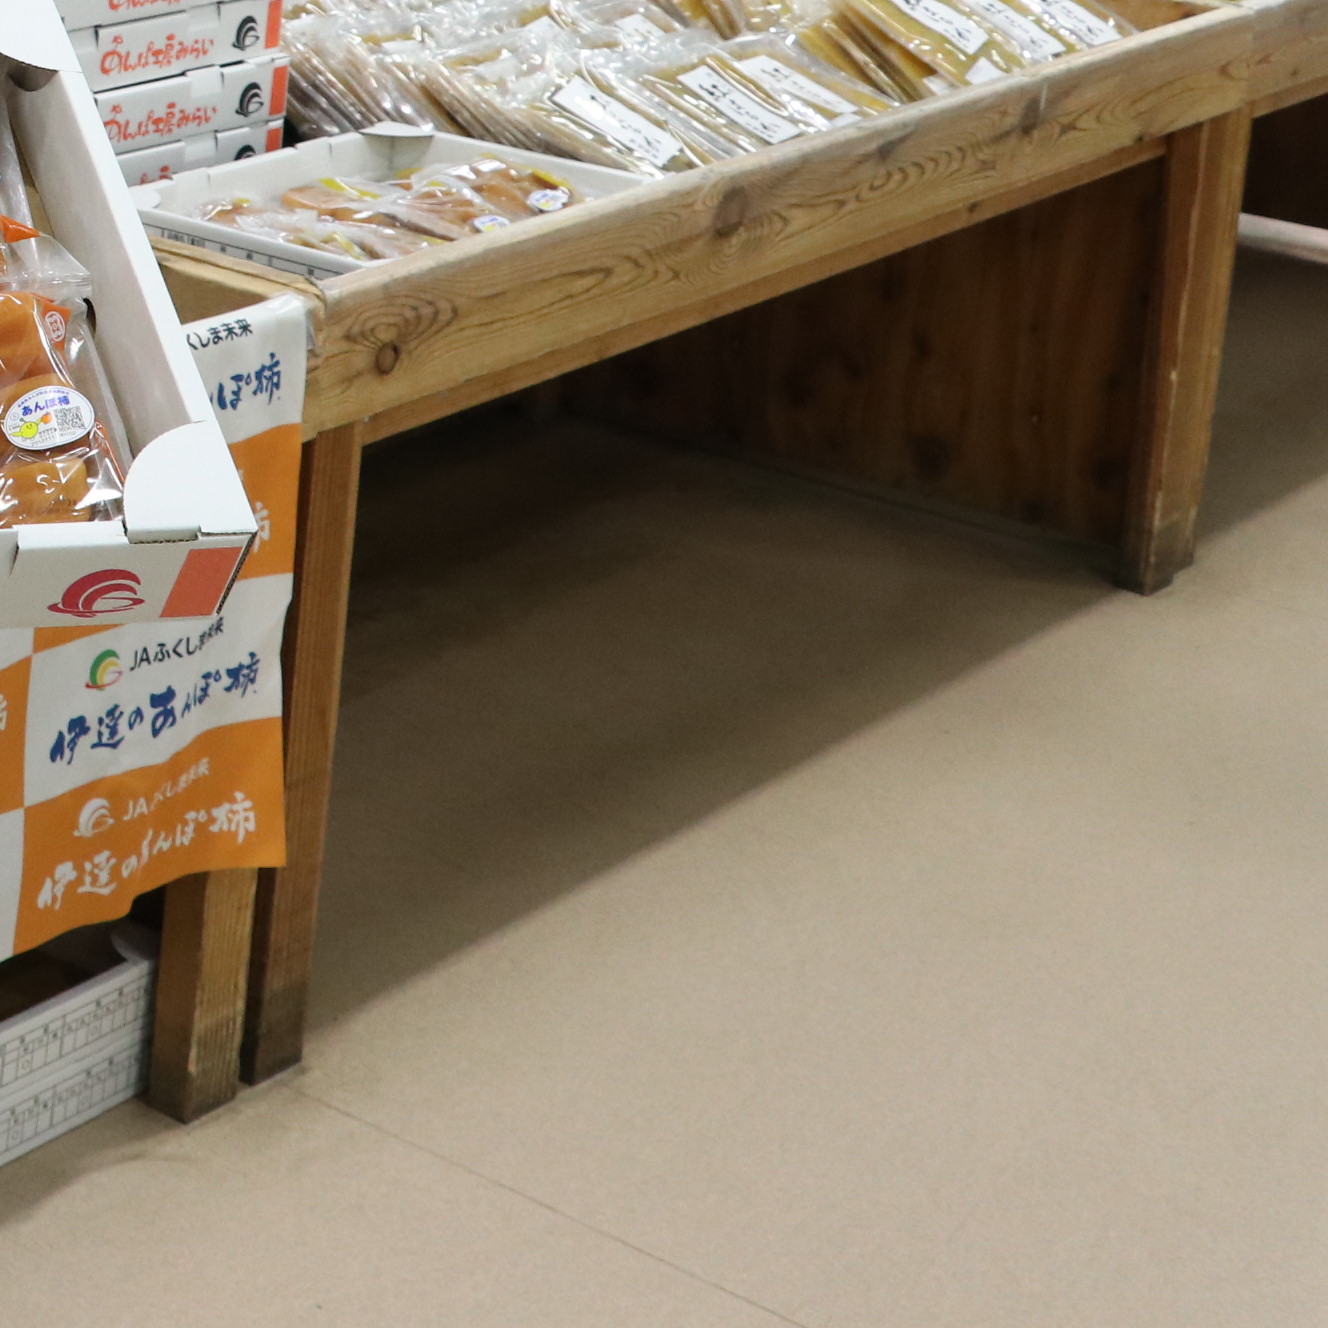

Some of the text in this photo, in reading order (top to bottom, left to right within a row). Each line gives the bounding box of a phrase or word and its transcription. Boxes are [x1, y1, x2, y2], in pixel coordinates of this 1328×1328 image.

[20, 395, 71, 417] あんぽ柿
[49, 651, 261, 766] 伊達のあんぽ柿
